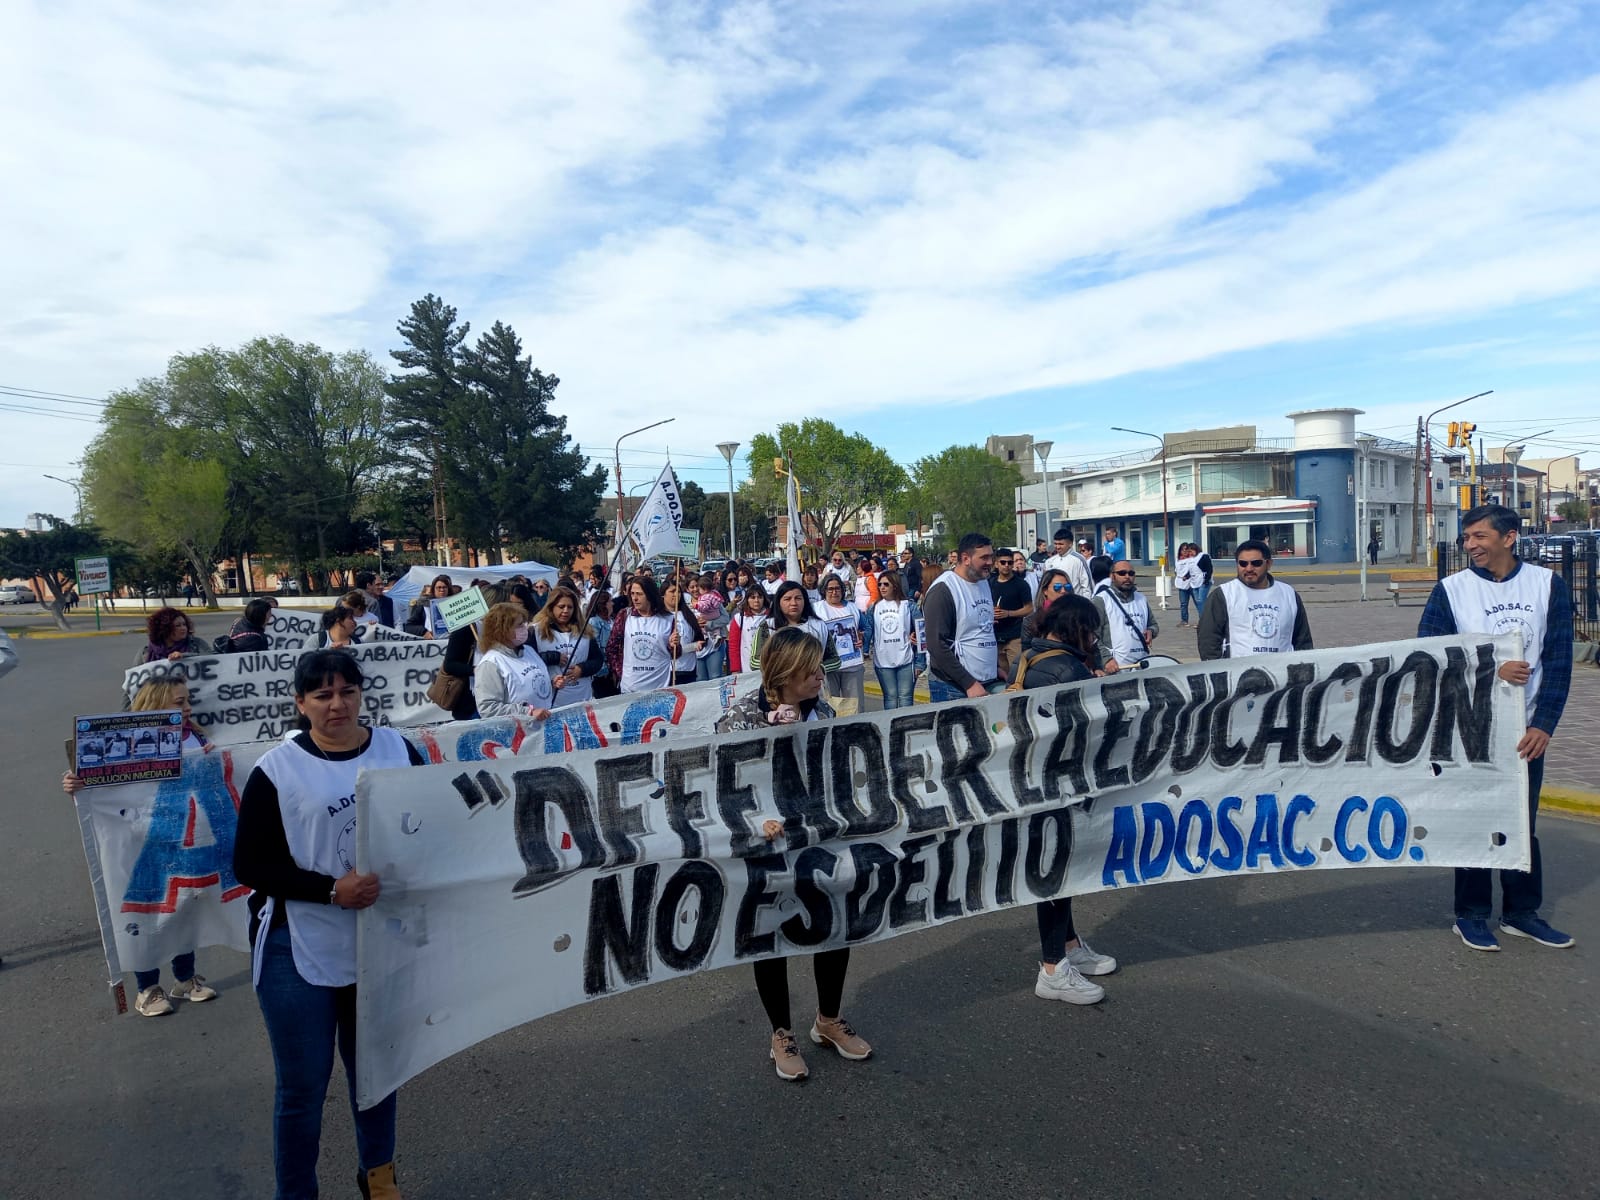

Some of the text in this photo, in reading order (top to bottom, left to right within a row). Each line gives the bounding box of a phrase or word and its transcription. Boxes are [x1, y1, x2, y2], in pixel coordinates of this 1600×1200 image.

[217, 682, 259, 701] SER
[364, 693, 395, 711] DE
[1007, 687, 1092, 808] LA
[1093, 642, 1496, 789] EDUCACION
[1102, 793, 1424, 888] ADOSAC CO.
[582, 859, 727, 997] NO
[733, 844, 834, 959] ES
